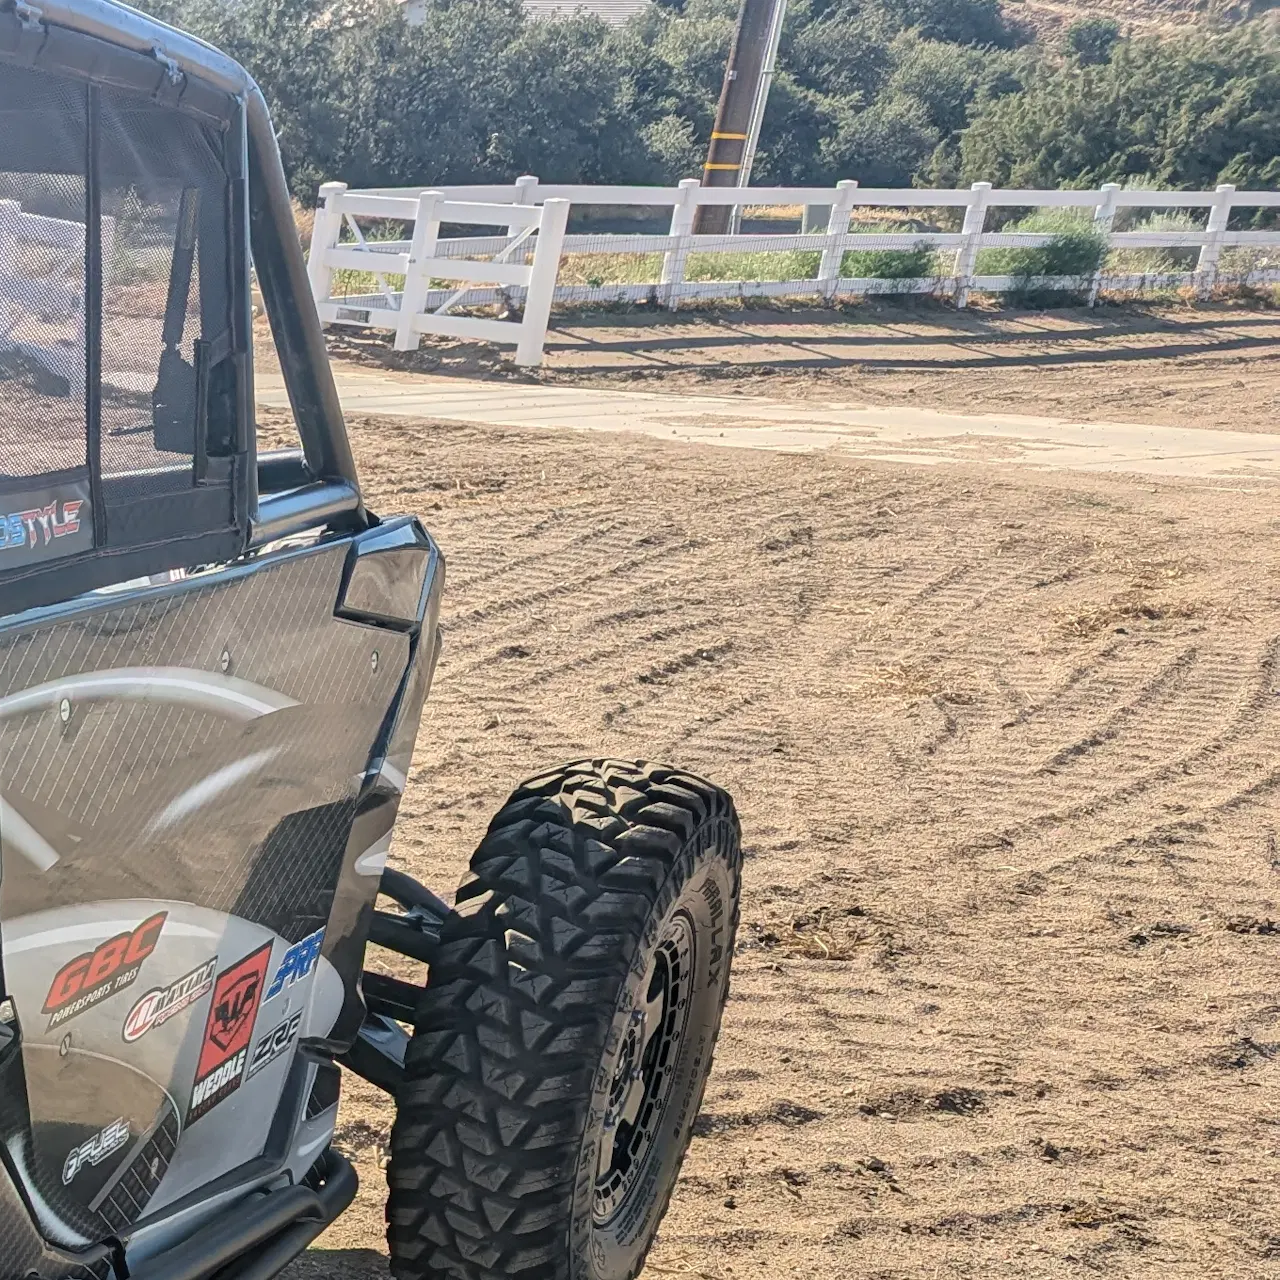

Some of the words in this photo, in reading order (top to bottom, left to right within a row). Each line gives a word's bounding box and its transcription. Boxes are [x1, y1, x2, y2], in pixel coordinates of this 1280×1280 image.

[46, 917, 165, 1008] GBC
[50, 981, 112, 1026] POWERSPORTS
[114, 966, 140, 989] TIRES
[191, 1049, 247, 1109] WEDDLE
